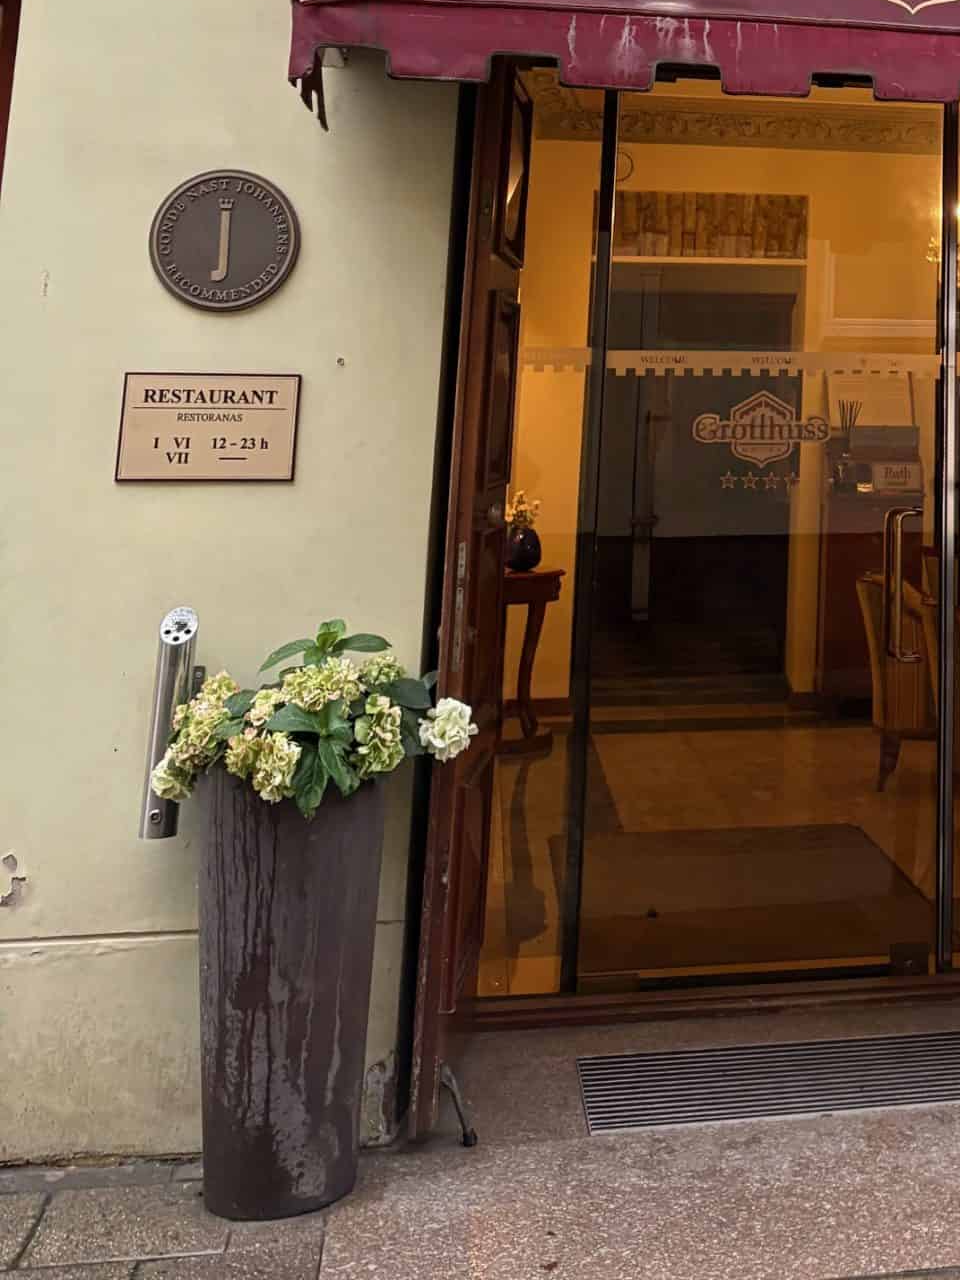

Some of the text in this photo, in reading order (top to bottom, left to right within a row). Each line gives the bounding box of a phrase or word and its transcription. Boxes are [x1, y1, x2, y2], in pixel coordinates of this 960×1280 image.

[187, 179, 230, 201] NAST
[237, 180, 288, 255] JOHANSENS
[167, 263, 279, 301] RECOMMENDED
[143, 389, 279, 405] RESTAURANT
[176, 413, 243, 422] RESTORANAS
[153, 437, 160, 449] I
[173, 437, 191, 449] VI
[212, 438, 227, 449] 12
[240, 438, 256, 449] 23
[260, 438, 269, 449] h
[166, 452, 190, 464] VII
